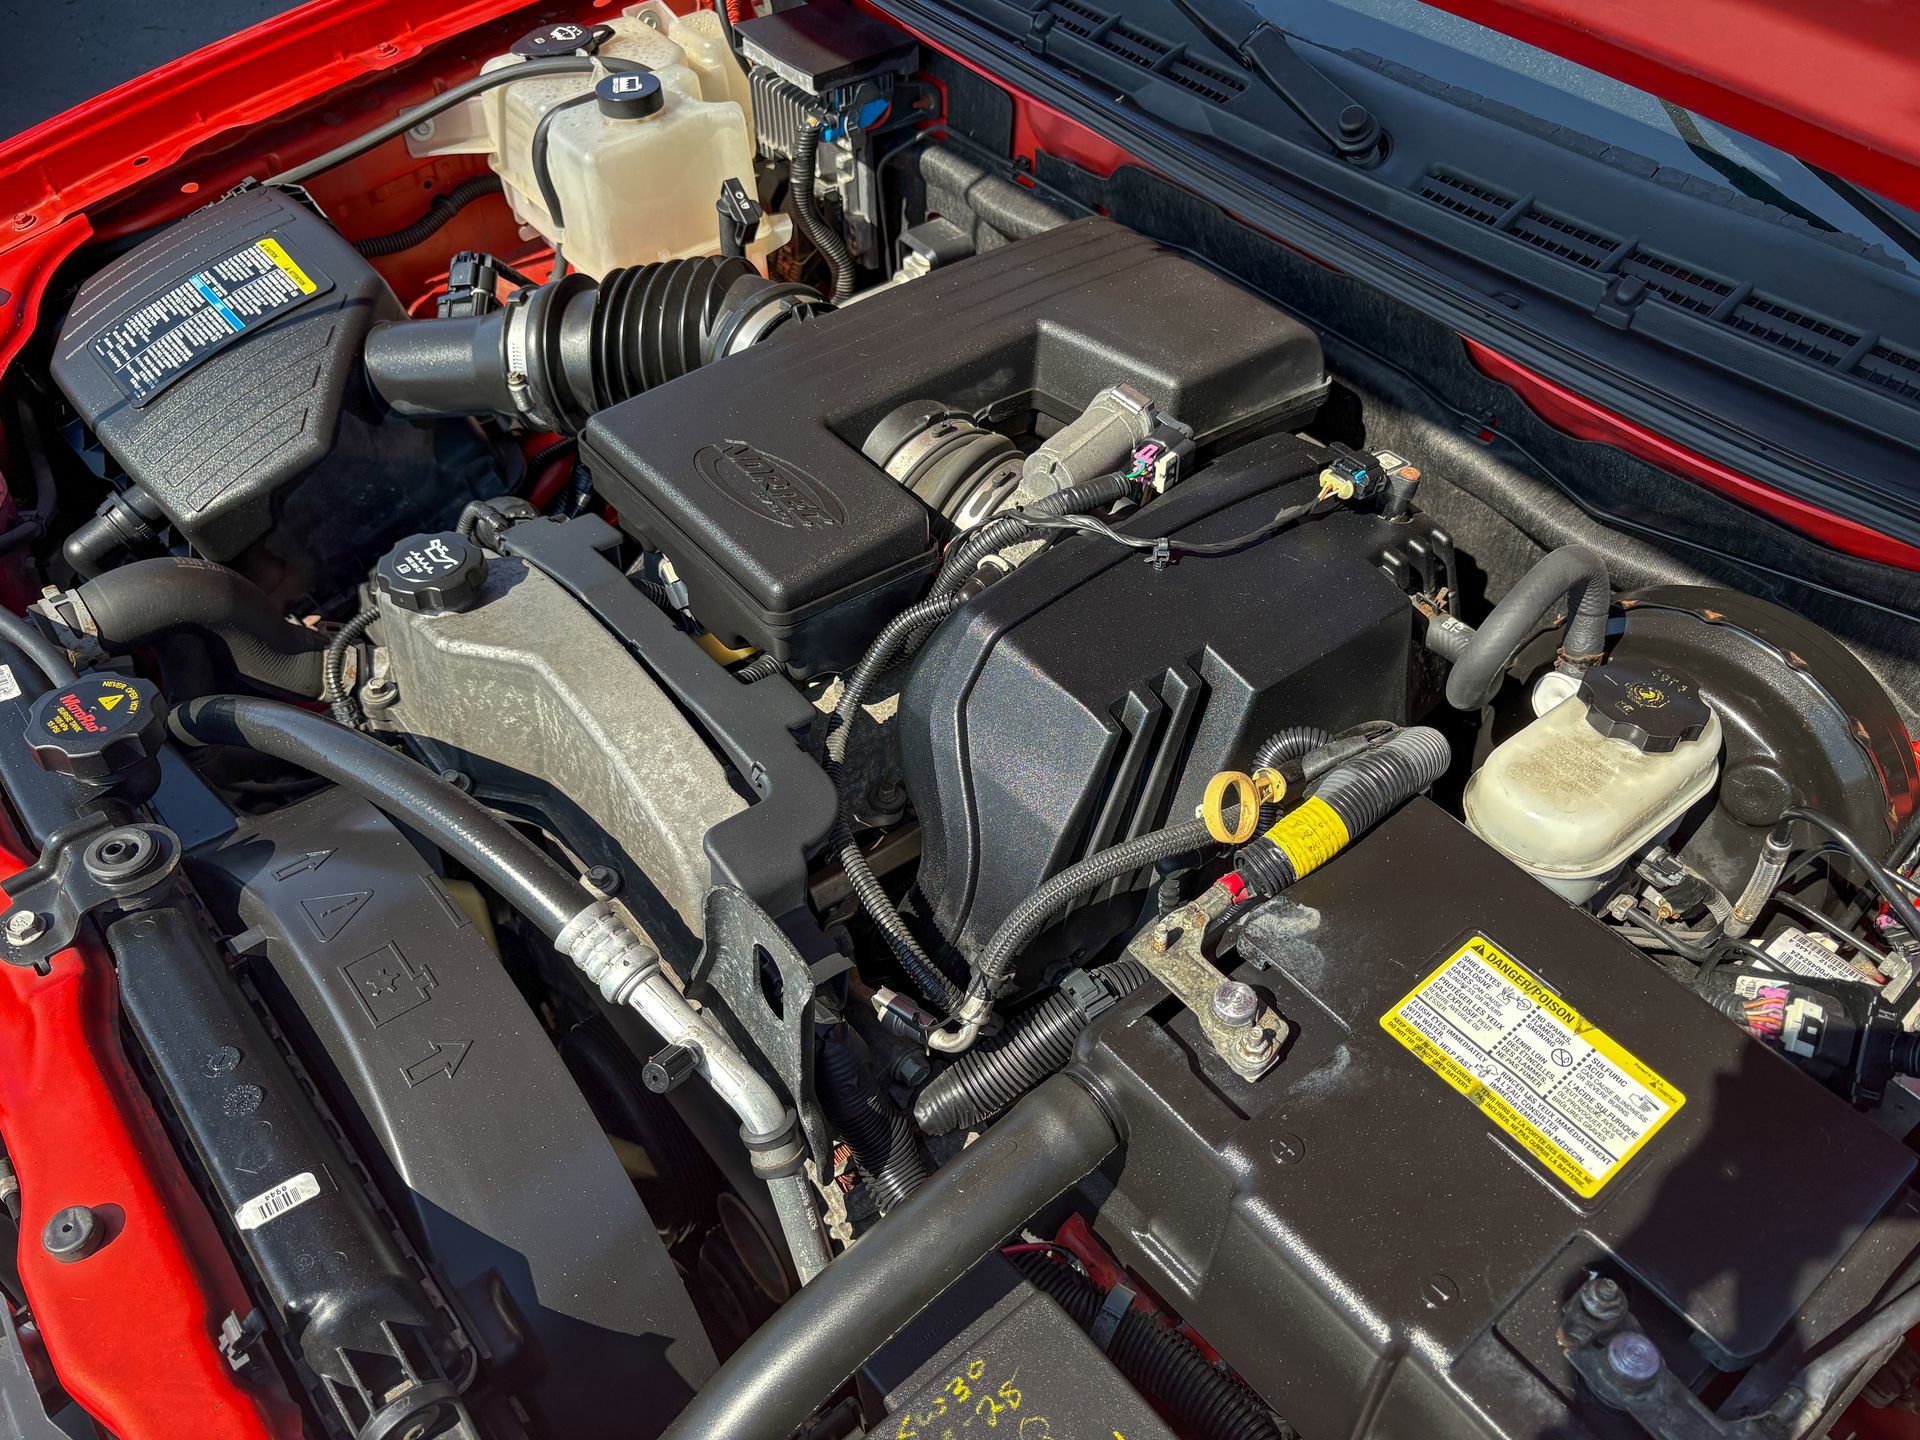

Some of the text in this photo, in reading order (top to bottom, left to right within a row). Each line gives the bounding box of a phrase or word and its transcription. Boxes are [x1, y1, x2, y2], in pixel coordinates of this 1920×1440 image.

[102, 680, 127, 690] NEVER
[125, 687, 139, 700] OPEN
[57, 706, 83, 733] SURGE TANK
[1450, 966, 1503, 1009] GASES CAN CAUSE
[1456, 961, 1493, 990] EXPLOSIVE
[1462, 955, 1502, 988] SHIELD EYES
[1485, 952, 1576, 1023] DANGER/POISON
[1422, 990, 1447, 1012] BLESSER
[1427, 986, 1482, 1031] RENDRE AVEUGLE OU
[1432, 981, 1493, 1032] GAZ EXPLOSIF PEUT
[1445, 971, 1503, 1018] BLINDNESS OR INJURY
[1405, 1005, 1445, 1038] WITH WATER.
[1411, 999, 1488, 1063] FLUSH EYES IMMEDIATELY
[1471, 1003, 1487, 1016] LES
[1484, 1014, 1505, 1031] YEUX
[1525, 1022, 1556, 1048] SMOKING
[1530, 1018, 1565, 1046] FLAMES OR
[1535, 1013, 1546, 1023] NO
[1392, 1017, 1406, 1028] KEEP
[1405, 1027, 1416, 1037] OUT
[1422, 1041, 1440, 1057] REACH
[1445, 1061, 1473, 1085] CHILDREN.
[1400, 1009, 1473, 1071] GET MEDICAL HELP FAST.
[1501, 1044, 1516, 1057] DES
[1506, 1040, 1521, 1052] DES
[1512, 1035, 1548, 1064] TENIR LOIN
[1395, 1027, 1407, 1037] NOT
[1421, 1049, 1433, 1060] NOT
[1432, 1058, 1447, 1071] OPEN
[1445, 1069, 1470, 1091] BATTERY.
[1495, 1049, 1543, 1088] NE PAS FUMER
[1585, 1062, 1605, 1080] ACID
[1590, 1057, 1628, 1088] SULFURIC
[1500, 1071, 1525, 1092] RINCER
[1523, 1091, 1538, 1104] LES
[1536, 1102, 1555, 1119] YEUX
[1561, 1085, 1629, 1141] PEUT RENDRE AVEUGLE
[1567, 1080, 1639, 1139] L'ACIDE SULFURIQUE
[1575, 1073, 1630, 1117] OR SEVERE BURNS
[1580, 1068, 1594, 1080] CAN
[1593, 1078, 1614, 1096] CAUSE
[1613, 1094, 1648, 1123] BLINDNESS
[1474, 1092, 1487, 1103] PAS
[1517, 1129, 1530, 1141] PAS
[1528, 1139, 1550, 1158] OUVRIR
[1479, 1087, 1496, 1102] TENIR
[1494, 1101, 1511, 1115] HORS
[1545, 1144, 1557, 1155] DES
[1520, 1099, 1559, 1132] CONSULTER
[1541, 1127, 1553, 1137] UN
[1556, 1090, 1616, 1139] OU PROVOQUER DES
[1582, 1120, 1608, 1142] GRAVES
